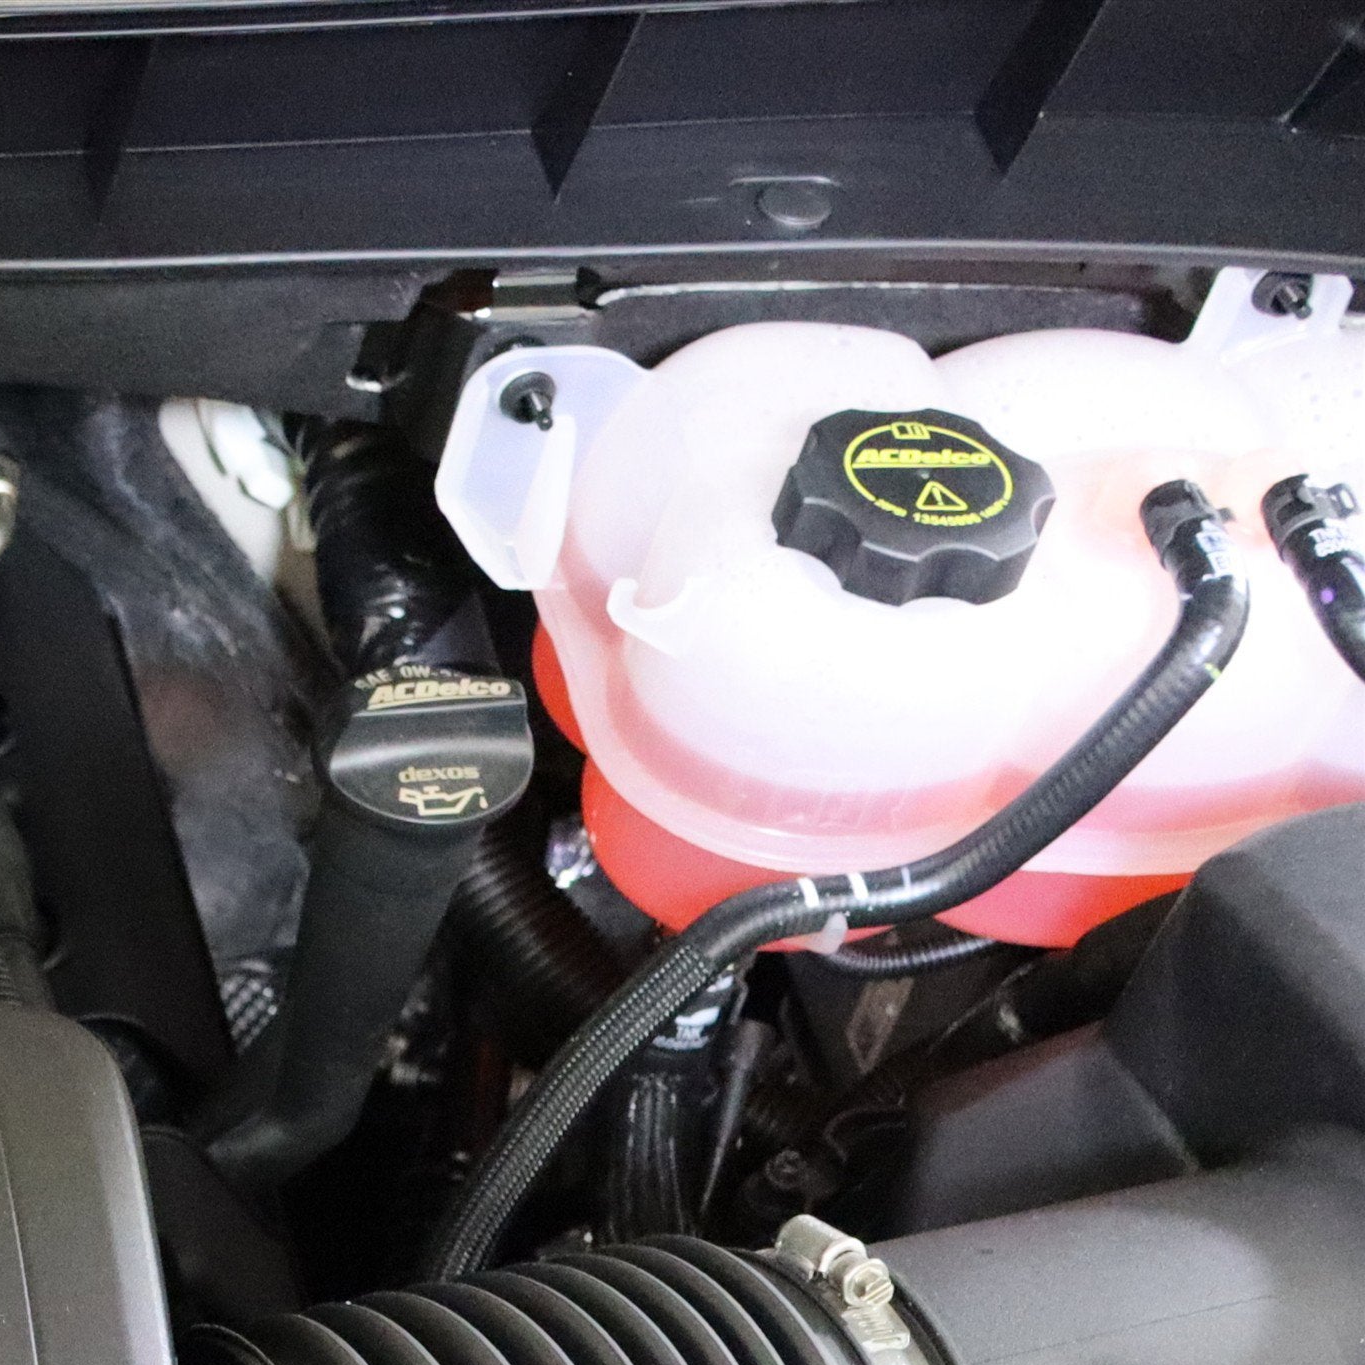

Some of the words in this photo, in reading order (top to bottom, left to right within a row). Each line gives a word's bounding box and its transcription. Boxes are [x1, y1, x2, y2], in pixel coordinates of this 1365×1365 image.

[854, 448, 993, 466] ACDelco
[369, 678, 512, 705] ACDelco
[398, 765, 481, 783] dexos
